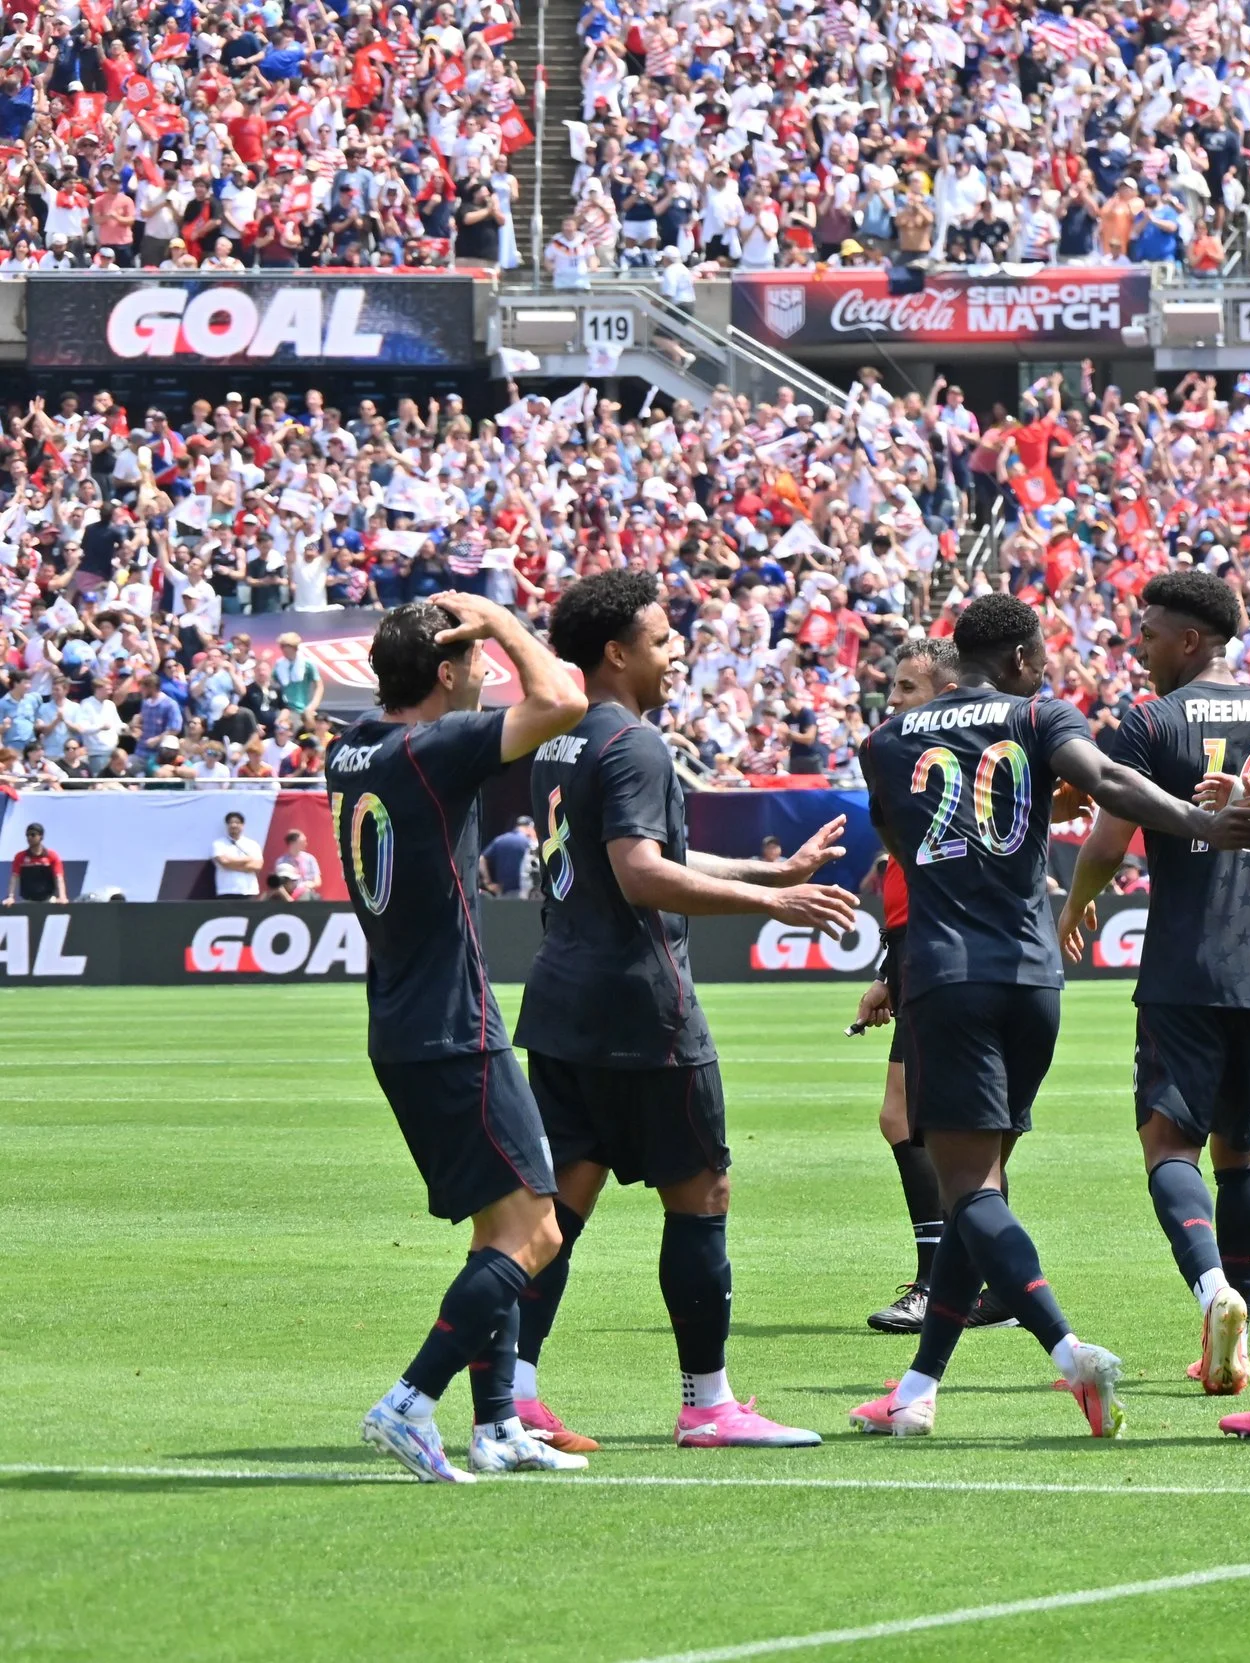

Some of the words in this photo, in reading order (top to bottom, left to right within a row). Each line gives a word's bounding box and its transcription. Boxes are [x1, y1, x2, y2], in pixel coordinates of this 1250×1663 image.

[831, 287, 962, 332] Coca-Cola
[967, 284, 1119, 305] SEND-OFF
[107, 288, 382, 357] GOAL
[588, 314, 628, 342] 119
[968, 304, 1119, 332] MATCH
[901, 702, 1010, 736] BALOGUN
[910, 740, 1032, 866] 20
[191, 913, 367, 974] GOA
